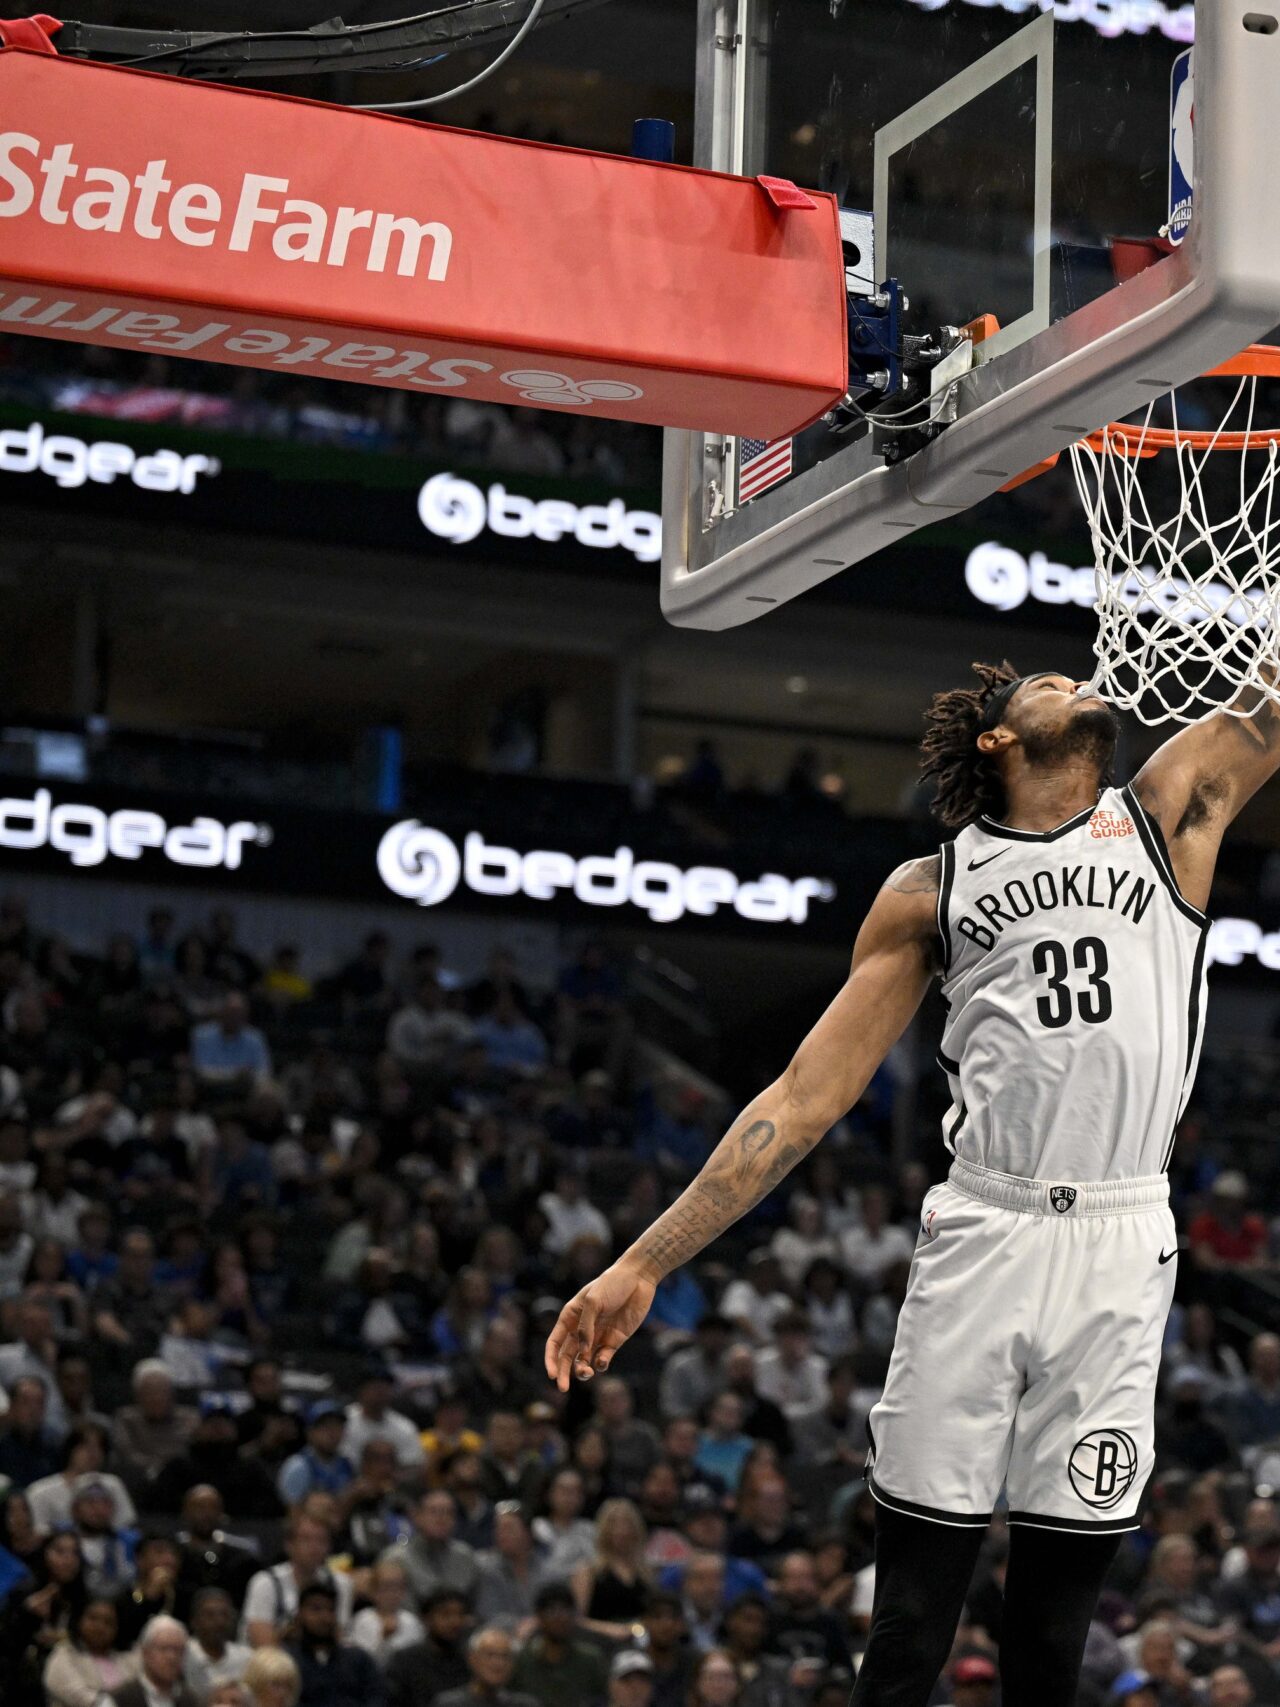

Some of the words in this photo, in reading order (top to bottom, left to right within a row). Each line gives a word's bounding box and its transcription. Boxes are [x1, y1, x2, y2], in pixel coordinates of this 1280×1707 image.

[1089, 817, 1131, 829] YOUR
[1090, 824, 1135, 839] GUIDE
[464, 831, 823, 925] bedgear
[957, 865, 1156, 952] BROOKLYN
[1032, 936, 1113, 1029] 33
[1051, 1188, 1075, 1200] NETS
[1094, 1440, 1118, 1497] B
